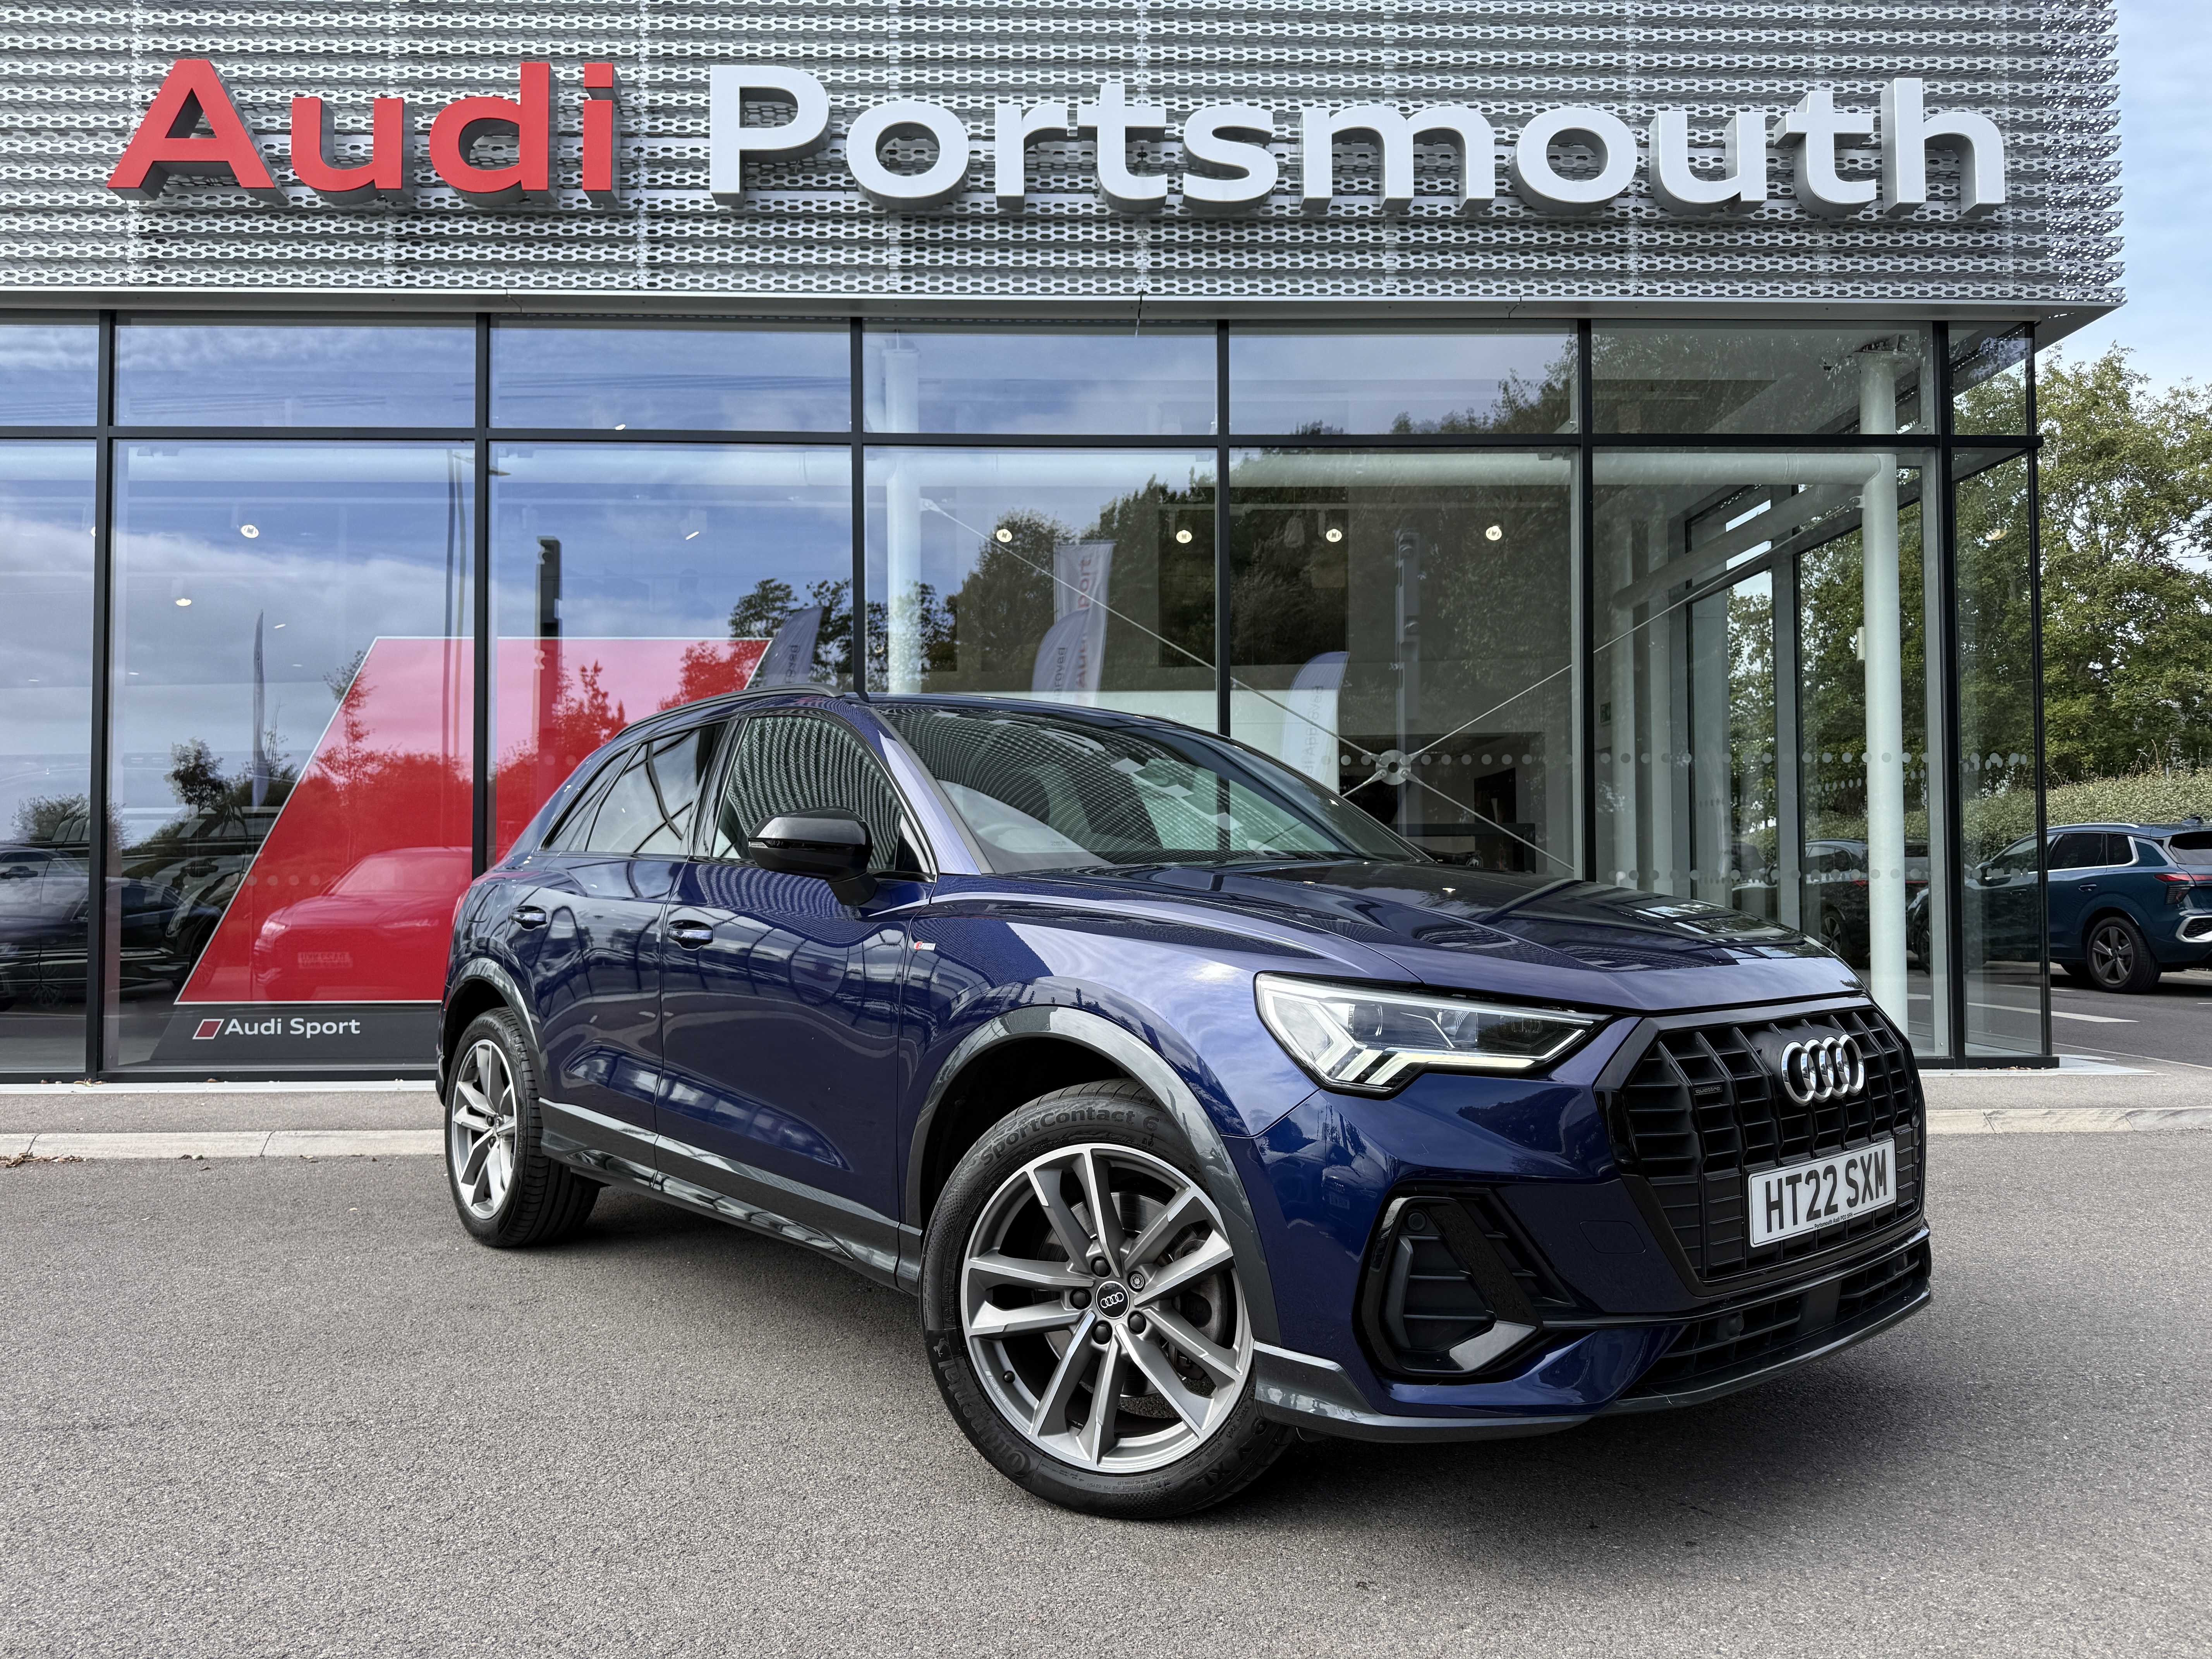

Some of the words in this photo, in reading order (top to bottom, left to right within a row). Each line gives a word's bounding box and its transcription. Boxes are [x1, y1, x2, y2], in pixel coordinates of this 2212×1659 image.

[106, 59, 613, 193] Audi
[710, 65, 2005, 203] Portsmouth
[225, 1018, 282, 1035] Audi
[290, 1018, 361, 1038] Sport
[980, 1106, 1135, 1166] SportContact
[1143, 1116, 1159, 1132] 6
[1765, 1164, 1838, 1233] HT22
[1845, 1149, 1887, 1208] SXM
[1814, 1219, 1833, 1229] Portsmouth
[989, 1376, 998, 1389] Audi
[996, 1388, 1007, 1403] Sport
